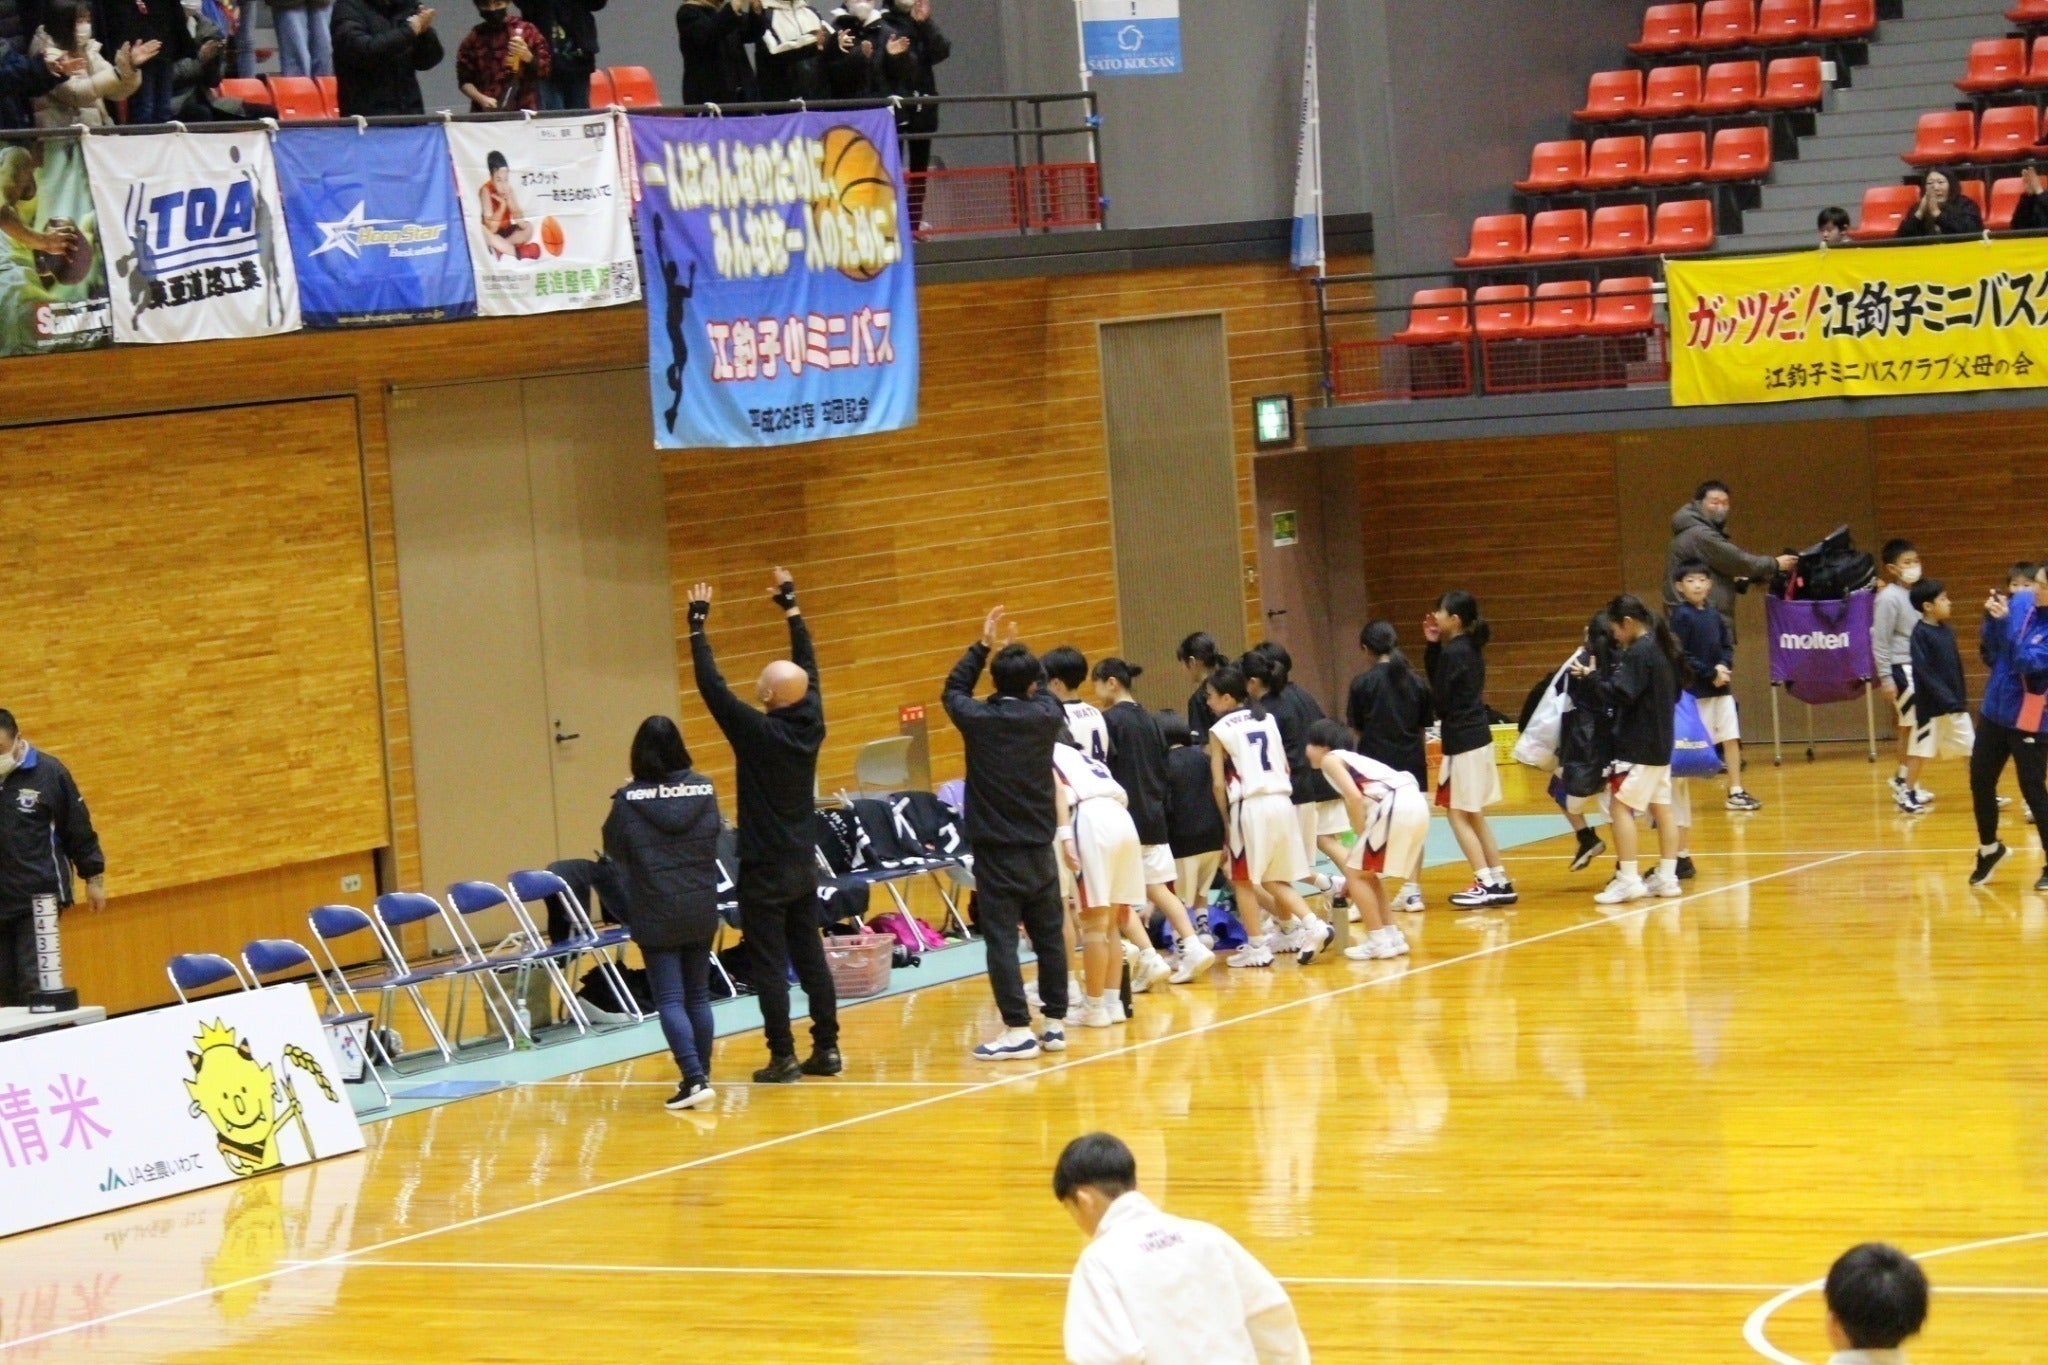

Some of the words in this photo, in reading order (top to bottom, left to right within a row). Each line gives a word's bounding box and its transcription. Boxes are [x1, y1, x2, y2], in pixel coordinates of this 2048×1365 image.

[1088, 58, 1121, 70] SATO
[150, 180, 255, 249] TOA
[1779, 631, 1850, 650] molten
[1246, 731, 1272, 771] 7
[626, 787, 658, 800] new
[36, 901, 44, 914] 5
[38, 919, 46, 932] 4
[40, 937, 47, 951] 3
[40, 956, 49, 969] 2
[43, 974, 49, 988] 1
